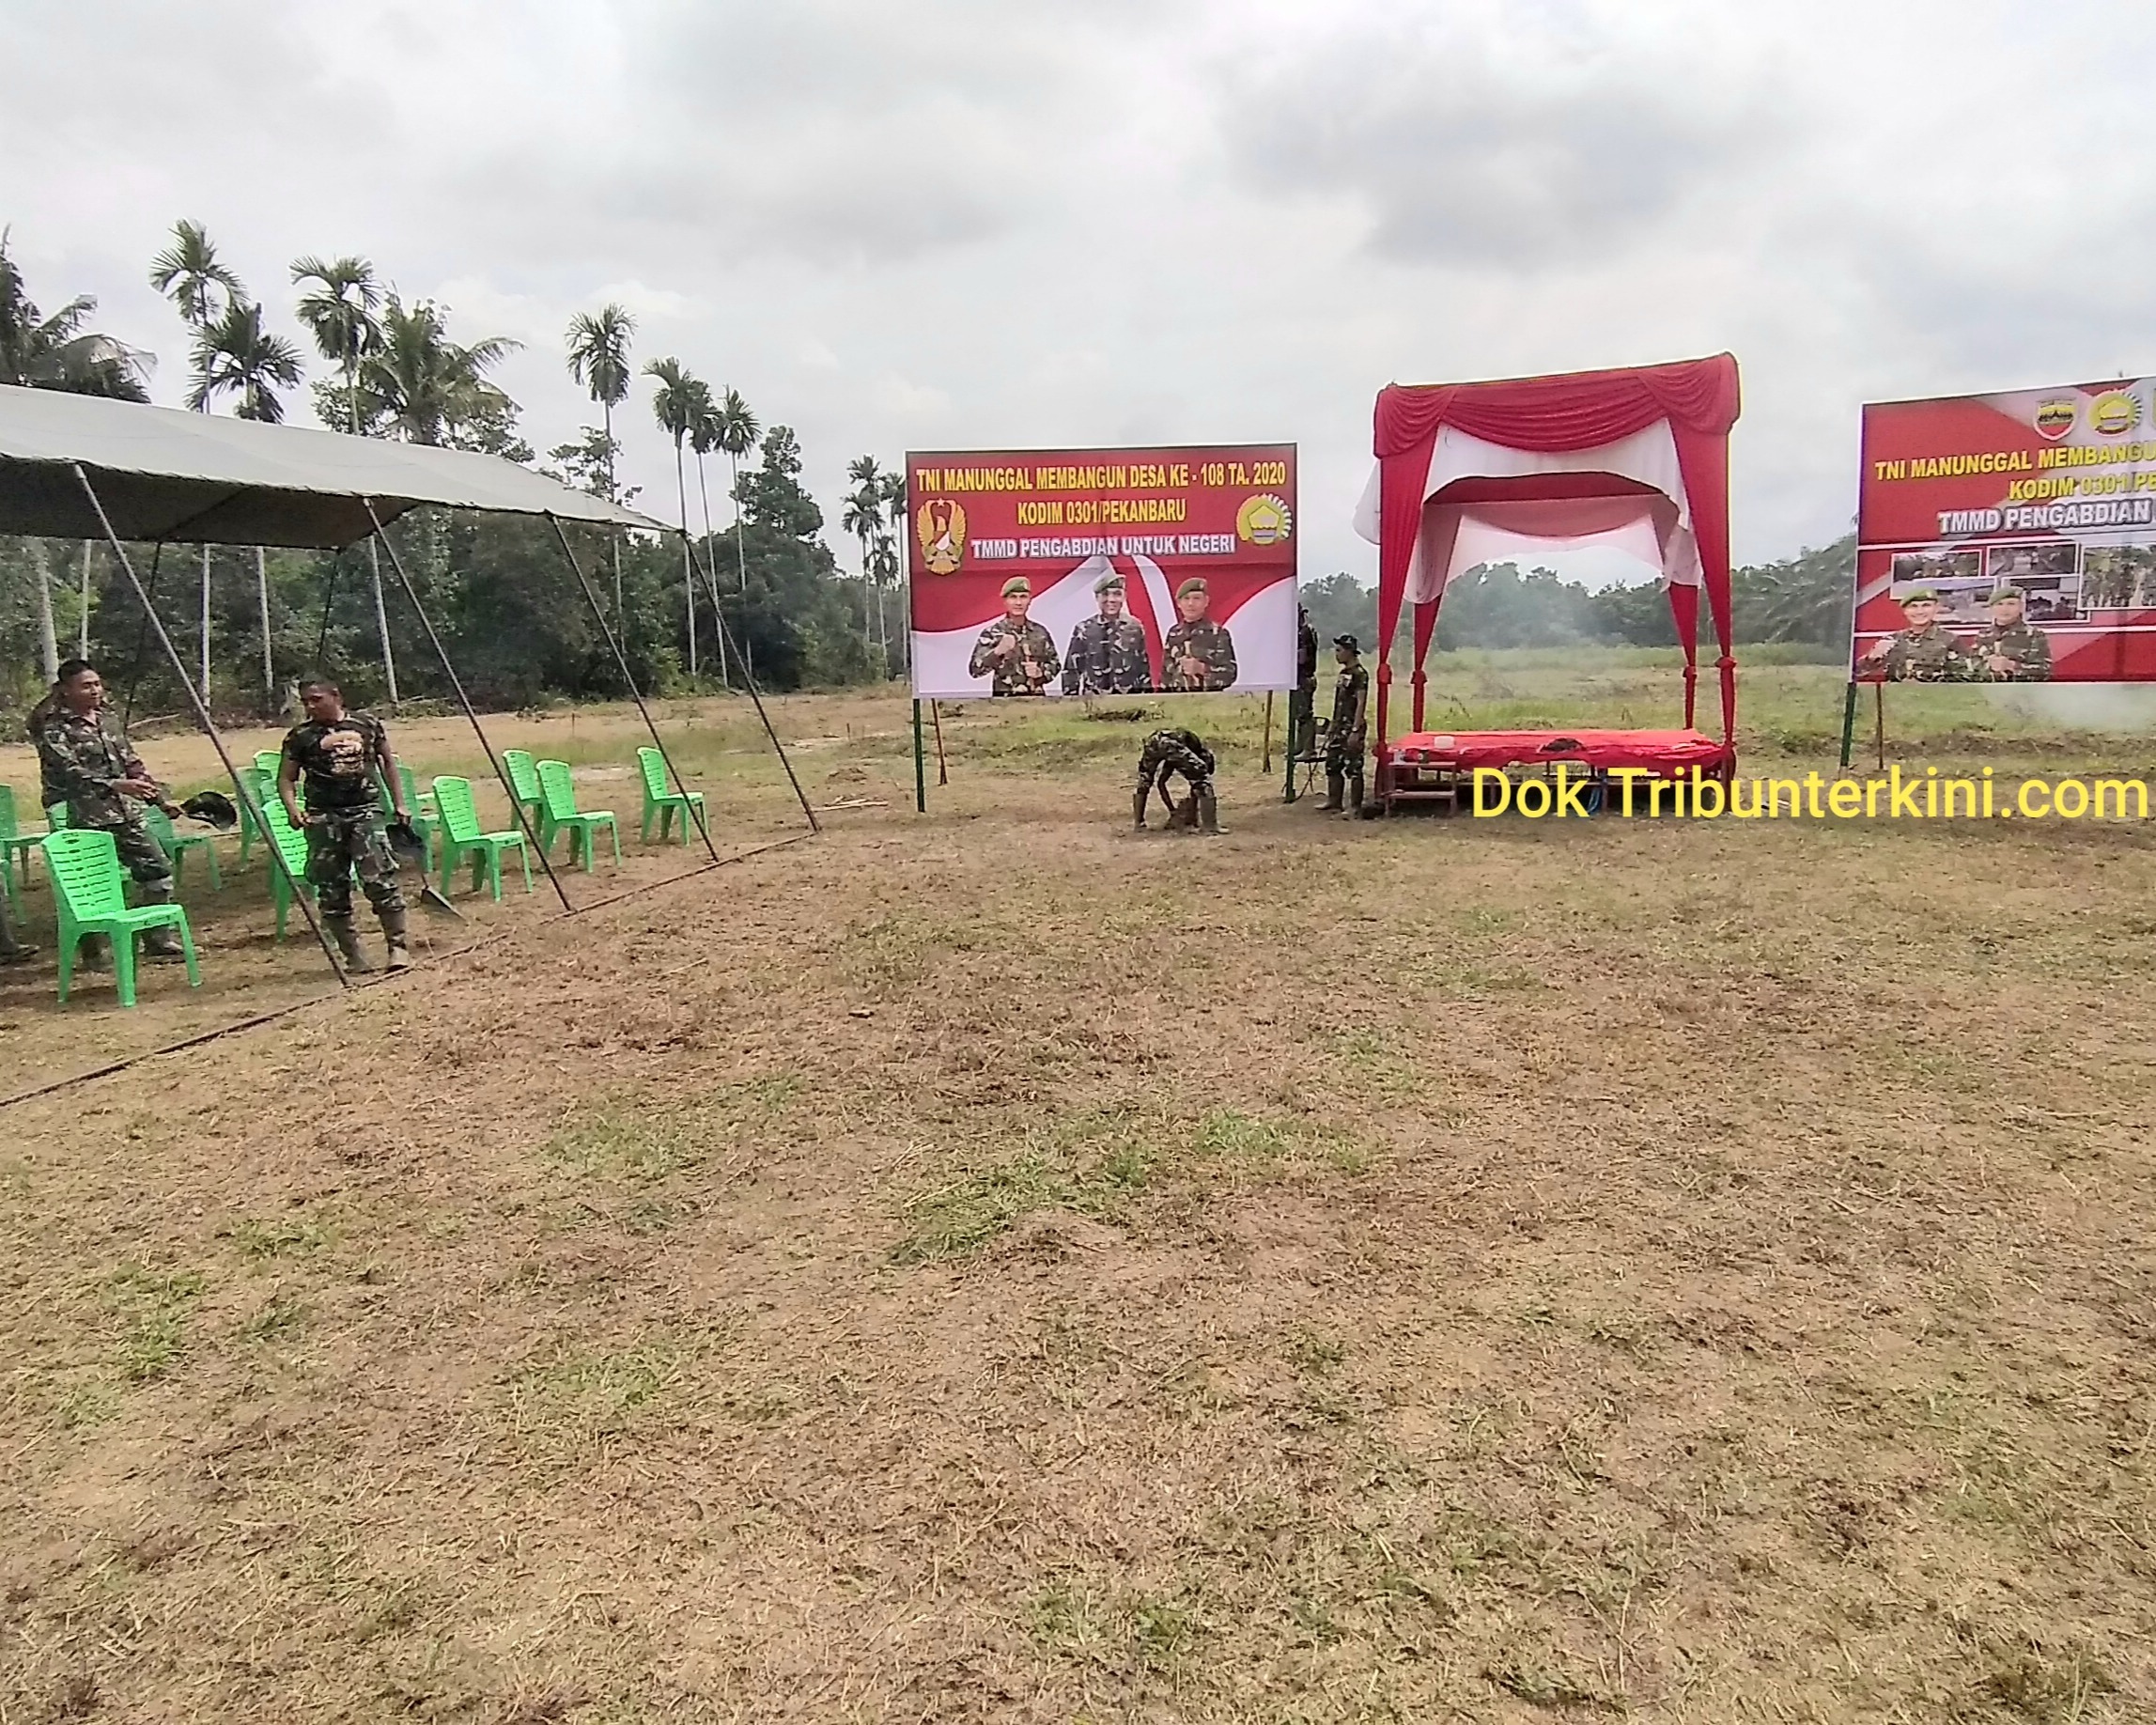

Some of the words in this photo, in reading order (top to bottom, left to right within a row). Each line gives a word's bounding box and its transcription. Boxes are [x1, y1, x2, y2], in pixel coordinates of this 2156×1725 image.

[916, 468, 941, 491] TNI
[944, 467, 1032, 490] MANUNGGAL
[1035, 465, 1127, 490] MEMBANGUN
[1130, 464, 1167, 489] DESA
[1169, 464, 1189, 487] KE
[1201, 463, 1225, 487] 108
[1228, 462, 1250, 486] TA.
[1252, 461, 1286, 485] 2020
[1875, 461, 1906, 480] TNI
[1910, 453, 2032, 478] MANUNGGAL
[2009, 478, 2075, 500] KODIM
[1017, 501, 1062, 525] KODIM
[1065, 499, 1187, 524] 0301/PEKANBARU
[1938, 509, 2001, 534] TMMD
[2004, 500, 2151, 530] PENGABDIAN
[971, 538, 1016, 558] TMMD
[1020, 536, 1118, 558] PENGABDIAN
[1122, 536, 1176, 555] UNTUK
[1178, 534, 1235, 553] NEGERI
